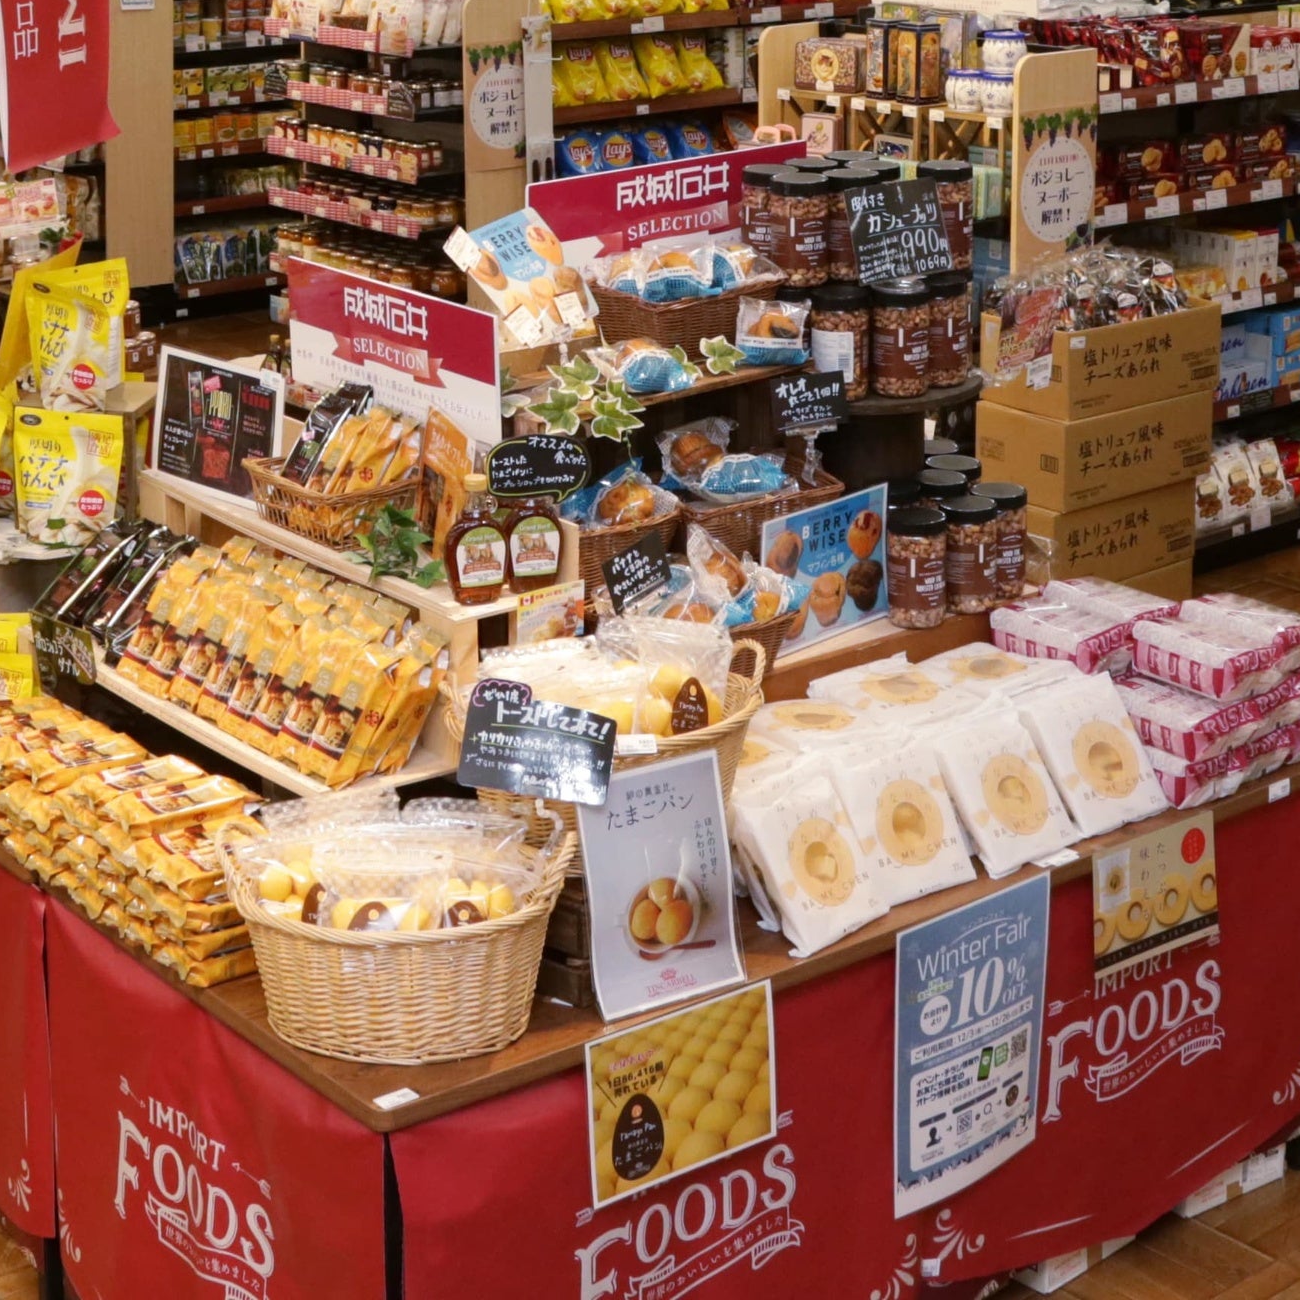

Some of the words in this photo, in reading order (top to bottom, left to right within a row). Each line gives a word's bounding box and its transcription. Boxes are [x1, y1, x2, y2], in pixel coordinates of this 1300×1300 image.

[616, 162, 730, 211] 成城石井
[627, 208, 725, 242] SELECTION
[867, 202, 938, 234] カシューナッツ
[499, 240, 532, 263] WISE
[343, 286, 428, 341] 成城石井
[353, 336, 425, 372] SELECTION
[1084, 334, 1173, 368] 塩トリュフ風味
[775, 380, 807, 399] オレオ
[1084, 360, 1161, 387] チーズあられ
[528, 436, 574, 450] オススメの
[1079, 421, 1165, 459] 塩トリュフ風味
[1079, 449, 1153, 477] チーズあられ
[801, 510, 854, 541] BERRY
[807, 527, 846, 553] WISE
[1067, 508, 1150, 547] 塩トリュフ風味
[1068, 534, 1138, 568] チーズあられ
[496, 701, 611, 740] トーストしてみて!
[1206, 702, 1255, 735] RUSK
[606, 794, 695, 831] たまごパン
[703, 817, 718, 877] ほんのり甘く
[916, 938, 990, 982] Winter
[994, 914, 1032, 949] Fair
[1002, 978, 1029, 1006] OFF
[1094, 950, 1173, 1000] IMPORT
[1042, 959, 1222, 1123] FOODS
[1102, 1020, 1212, 1093] 世界のおいしいを集めました
[613, 1075, 658, 1098] 売れている
[148, 1096, 226, 1172] IMPORT
[614, 1143, 663, 1167] たまごパン
[114, 1110, 275, 1278] FOODS
[574, 1144, 796, 1300] FOODS
[646, 1215, 784, 1300] 世界のおいしいを集めました
